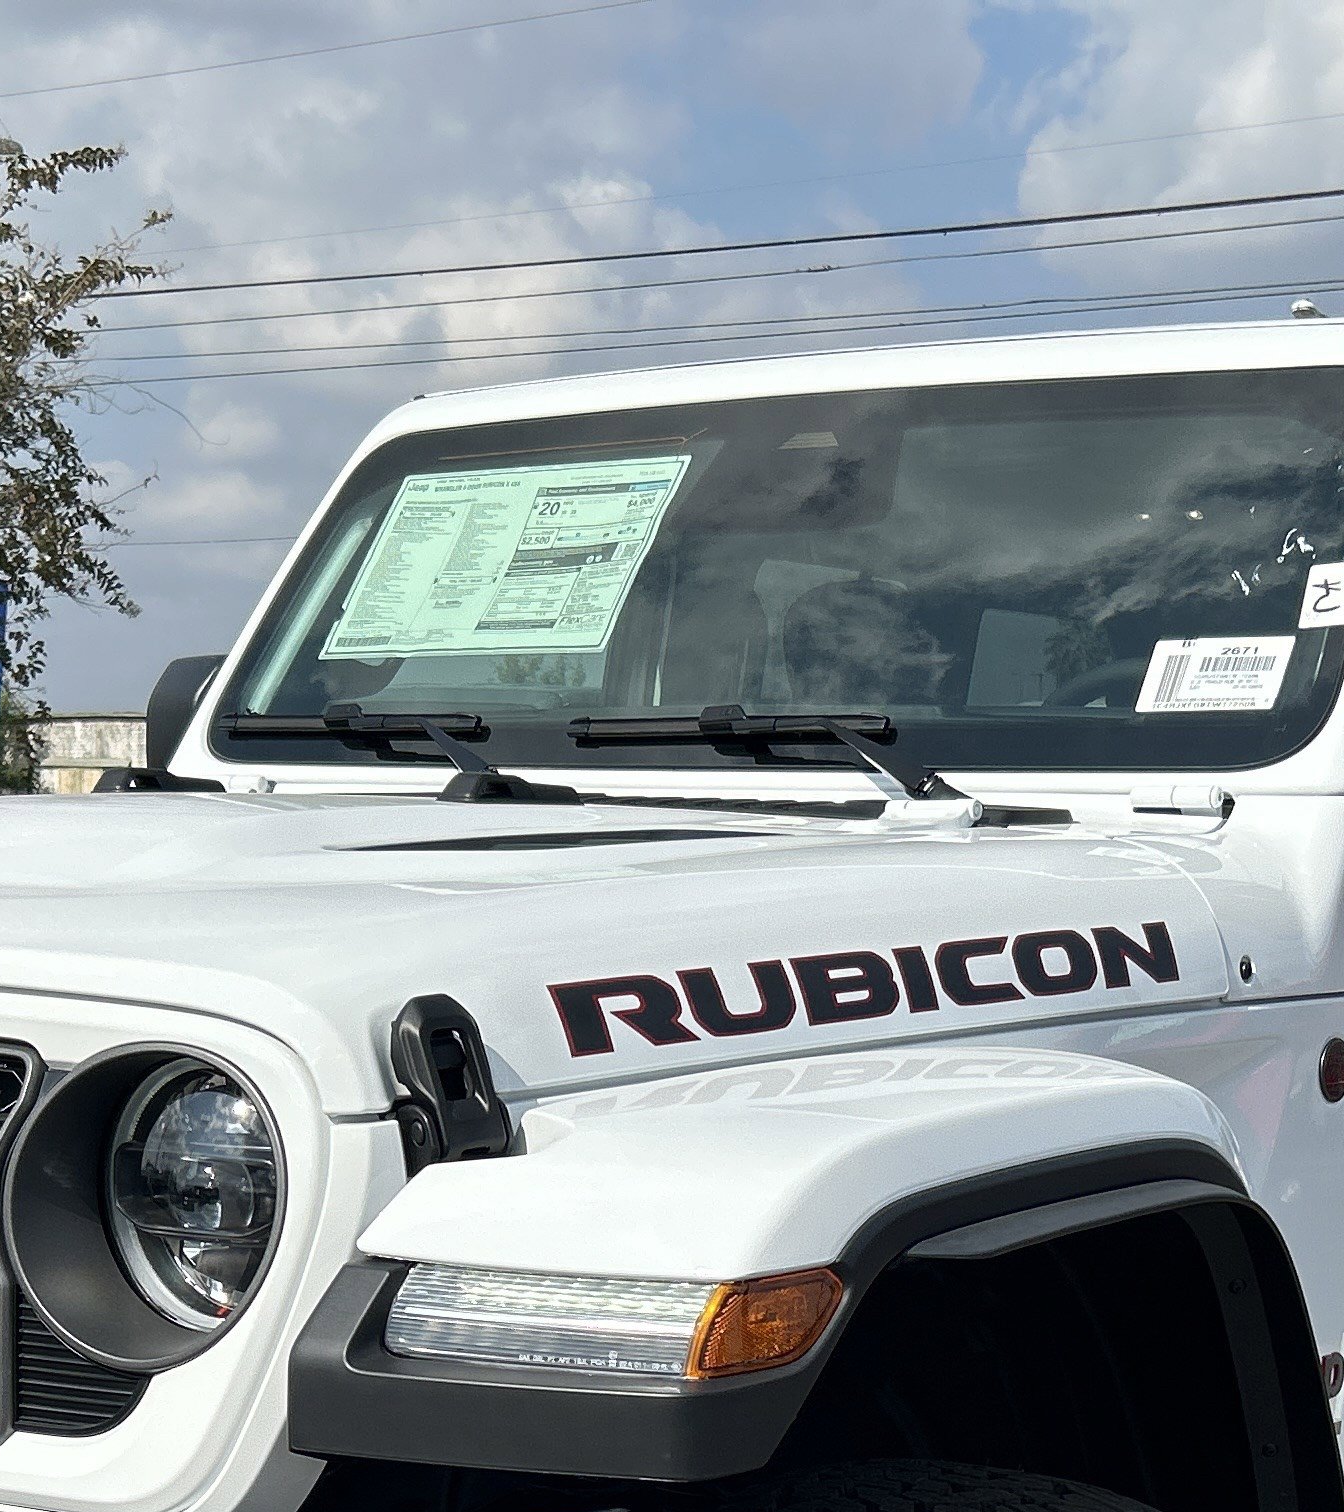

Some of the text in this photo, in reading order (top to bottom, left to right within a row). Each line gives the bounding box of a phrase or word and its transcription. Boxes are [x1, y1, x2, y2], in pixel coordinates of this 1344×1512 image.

[538, 501, 561, 516] 20
[1221, 647, 1259, 656] 2671
[546, 921, 1181, 1058] RUBICON
